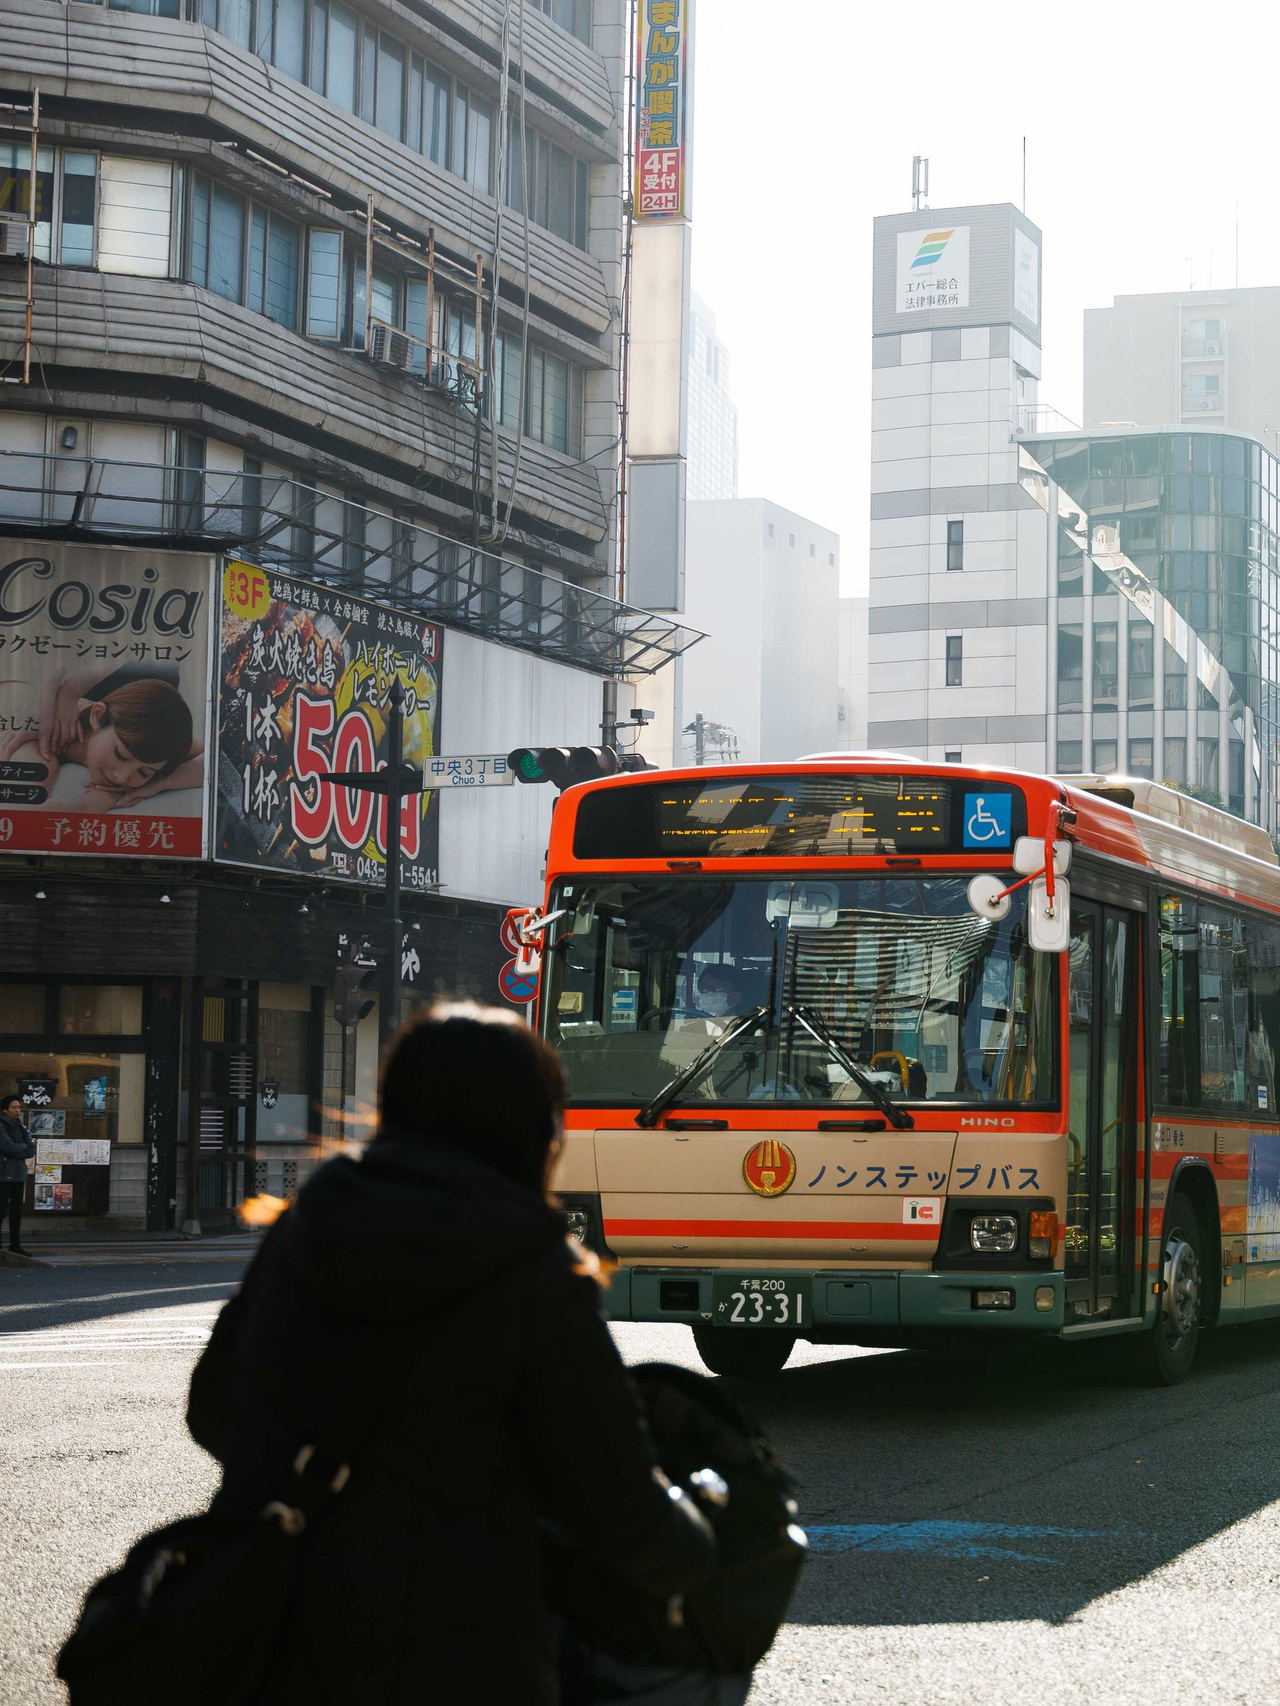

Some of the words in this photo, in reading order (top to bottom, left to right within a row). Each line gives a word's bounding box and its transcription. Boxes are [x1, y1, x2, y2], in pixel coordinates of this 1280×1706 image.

[648, 1, 677, 146] まんが喫茶
[643, 152, 677, 173] 4F
[643, 172, 677, 191] 受付
[643, 194, 676, 209] 24H
[905, 277, 959, 293] エバー総合
[905, 293, 959, 309] 法律事務所
[0, 557, 204, 640] Cosia
[236, 572, 265, 609] 3F
[272, 580, 320, 609] 地鶏と鮮魚
[333, 597, 370, 626] 全席個室
[249, 623, 336, 689] 炭火焼き鳥
[355, 639, 421, 681] ハイボール
[353, 670, 431, 713] レモンワー
[430, 758, 507, 776] 中央3丁目
[451, 775, 475, 785] Chuo
[478, 774, 485, 784] 3
[45, 817, 176, 850] 予約優先
[356, 856, 437, 886] 043-1-5541
[960, 1117, 1015, 1127] HINO
[807, 1163, 1041, 1191] ノンステップバス
[718, 1302, 728, 1312] か
[730, 1292, 802, 1324] 23-31
